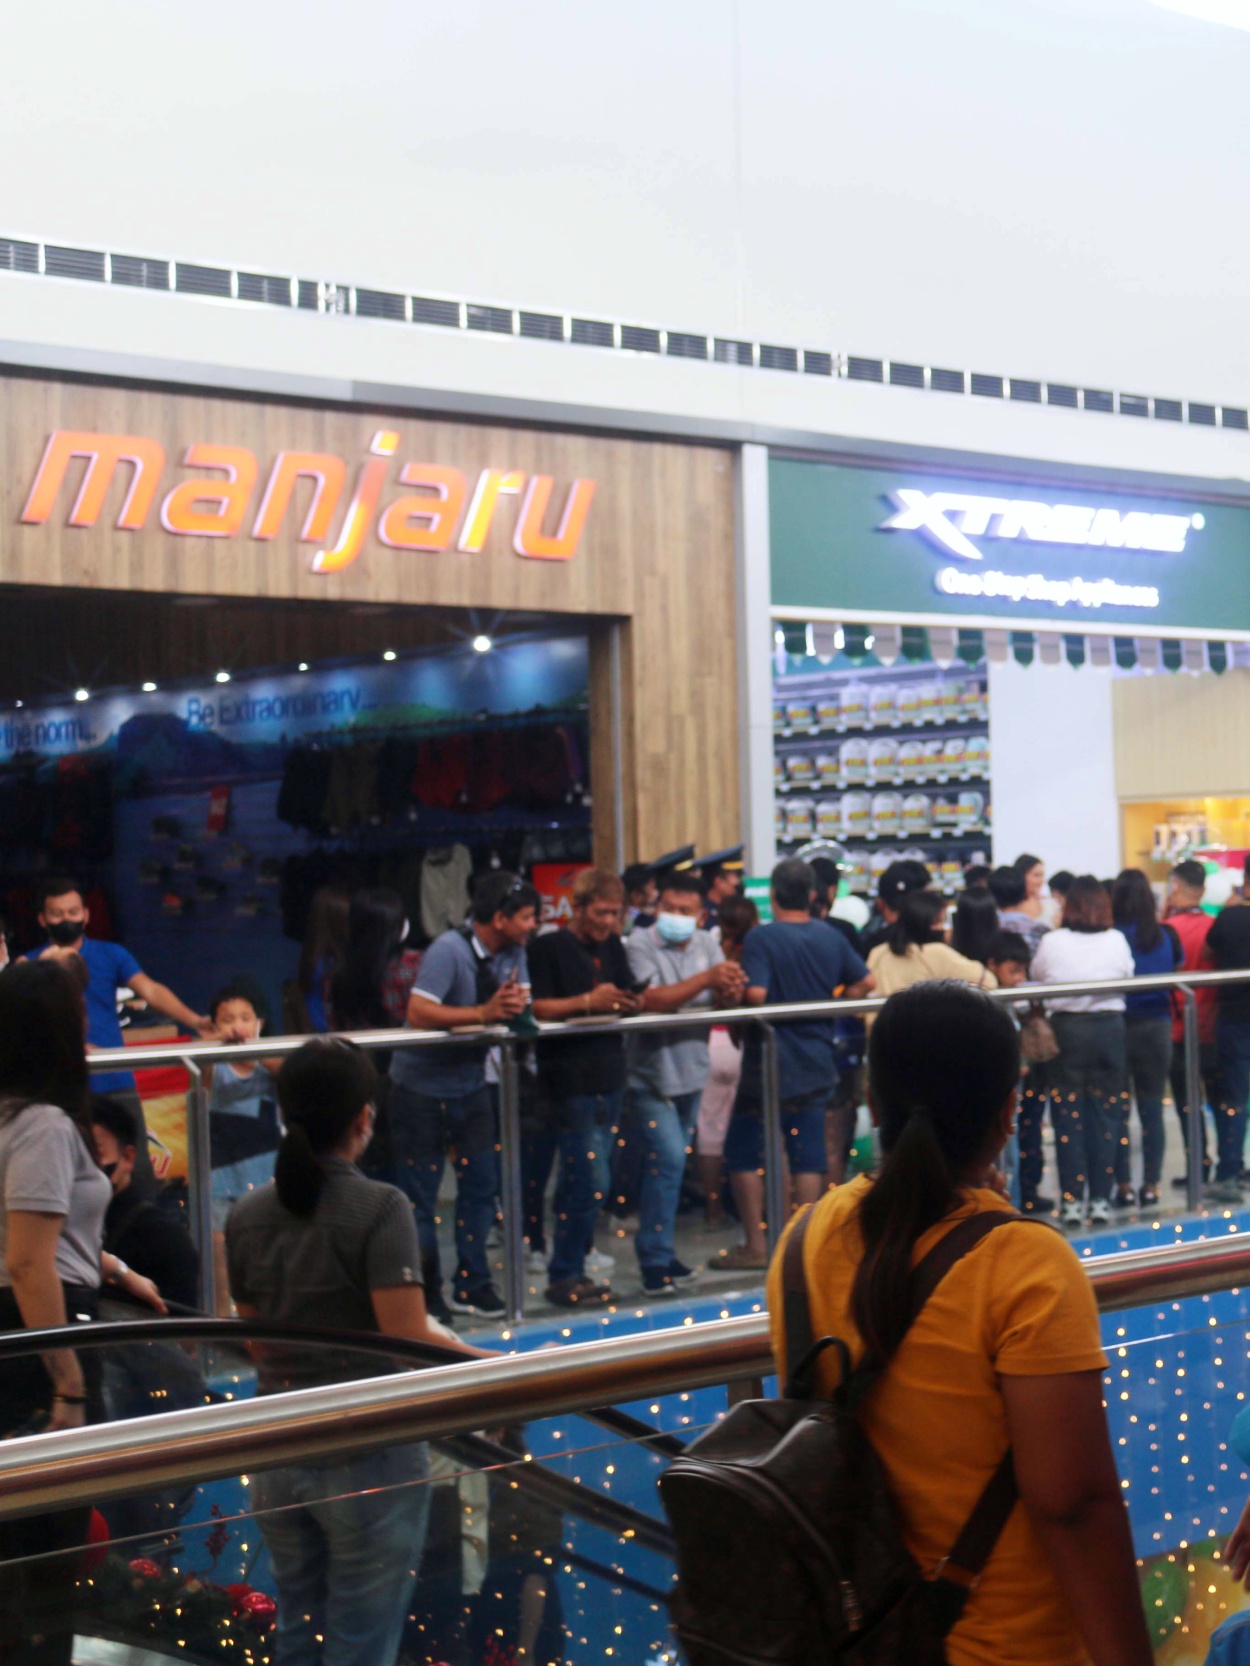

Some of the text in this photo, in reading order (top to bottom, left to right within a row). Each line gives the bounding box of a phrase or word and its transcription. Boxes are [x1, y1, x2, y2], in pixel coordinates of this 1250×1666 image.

[20, 430, 597, 573] manjaru
[883, 489, 1192, 560] XTREME
[187, 697, 215, 725] Be
